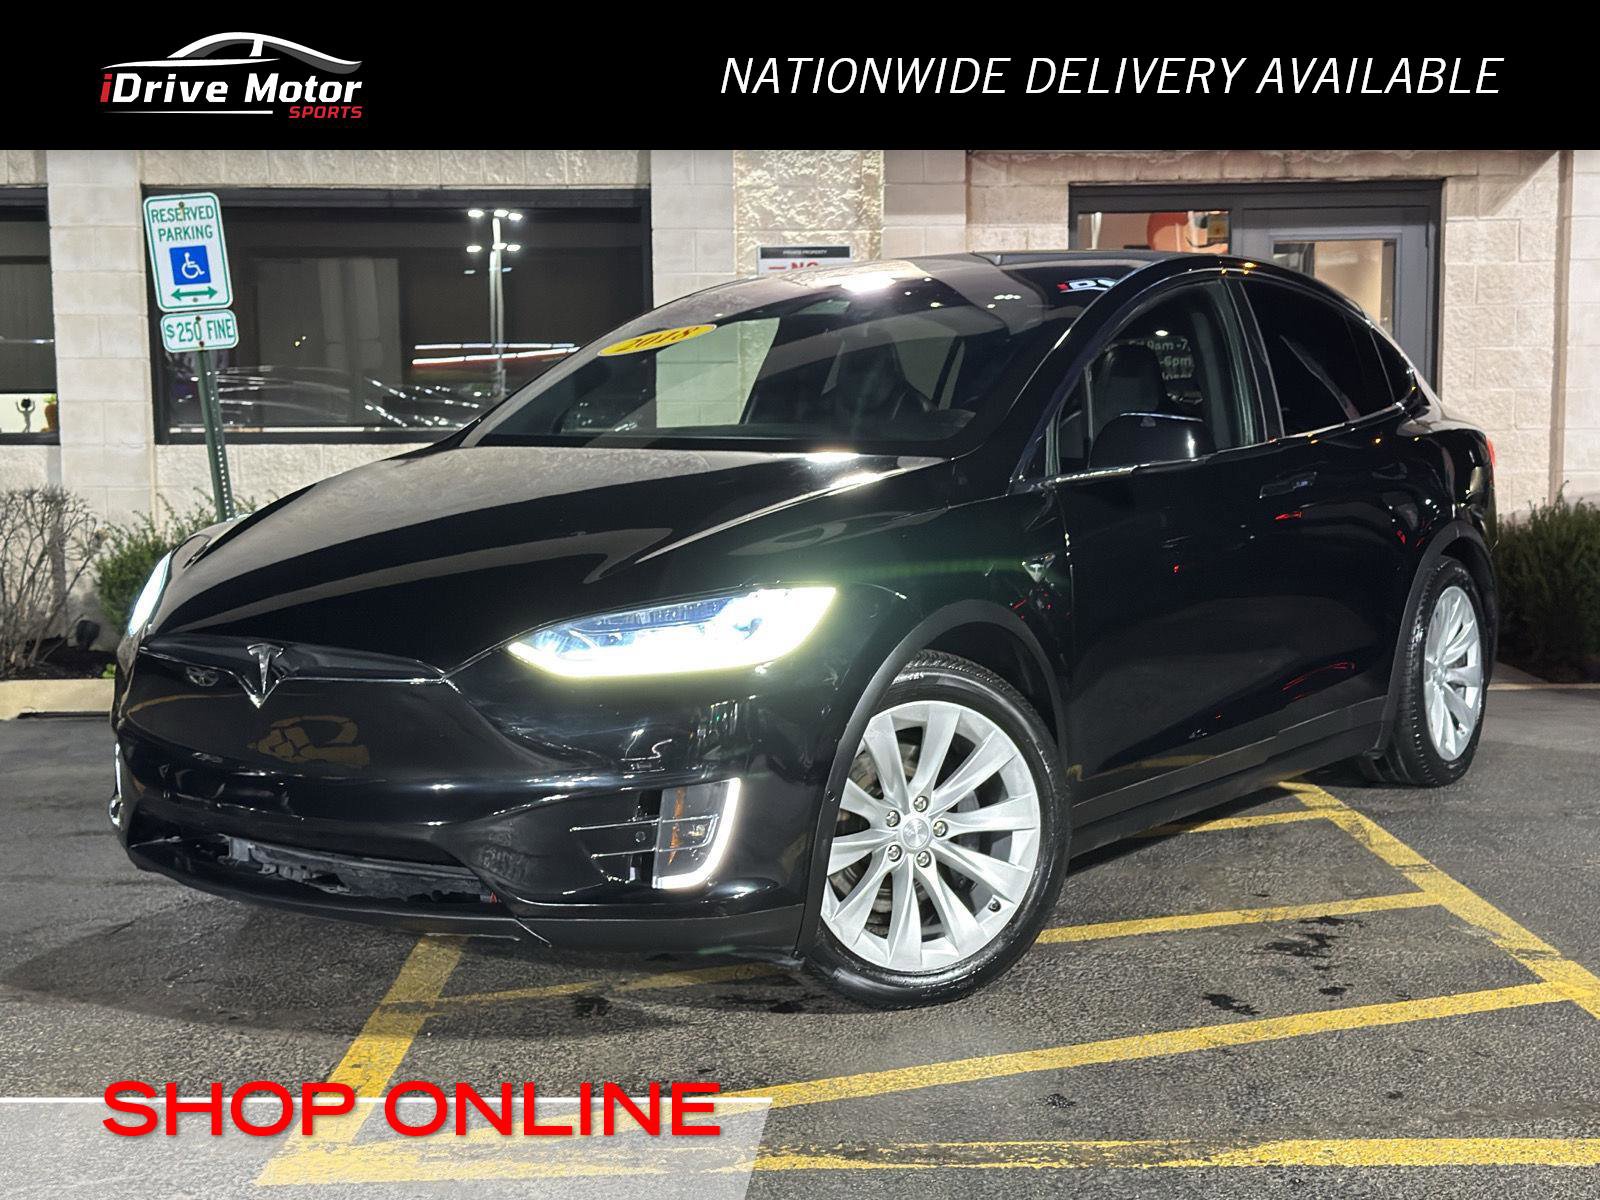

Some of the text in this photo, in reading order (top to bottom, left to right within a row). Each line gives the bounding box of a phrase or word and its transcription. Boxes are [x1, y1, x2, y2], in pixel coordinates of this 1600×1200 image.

[151, 205, 214, 223] RESERVED
[158, 224, 213, 242] PARKING
[206, 318, 235, 340] FINE
